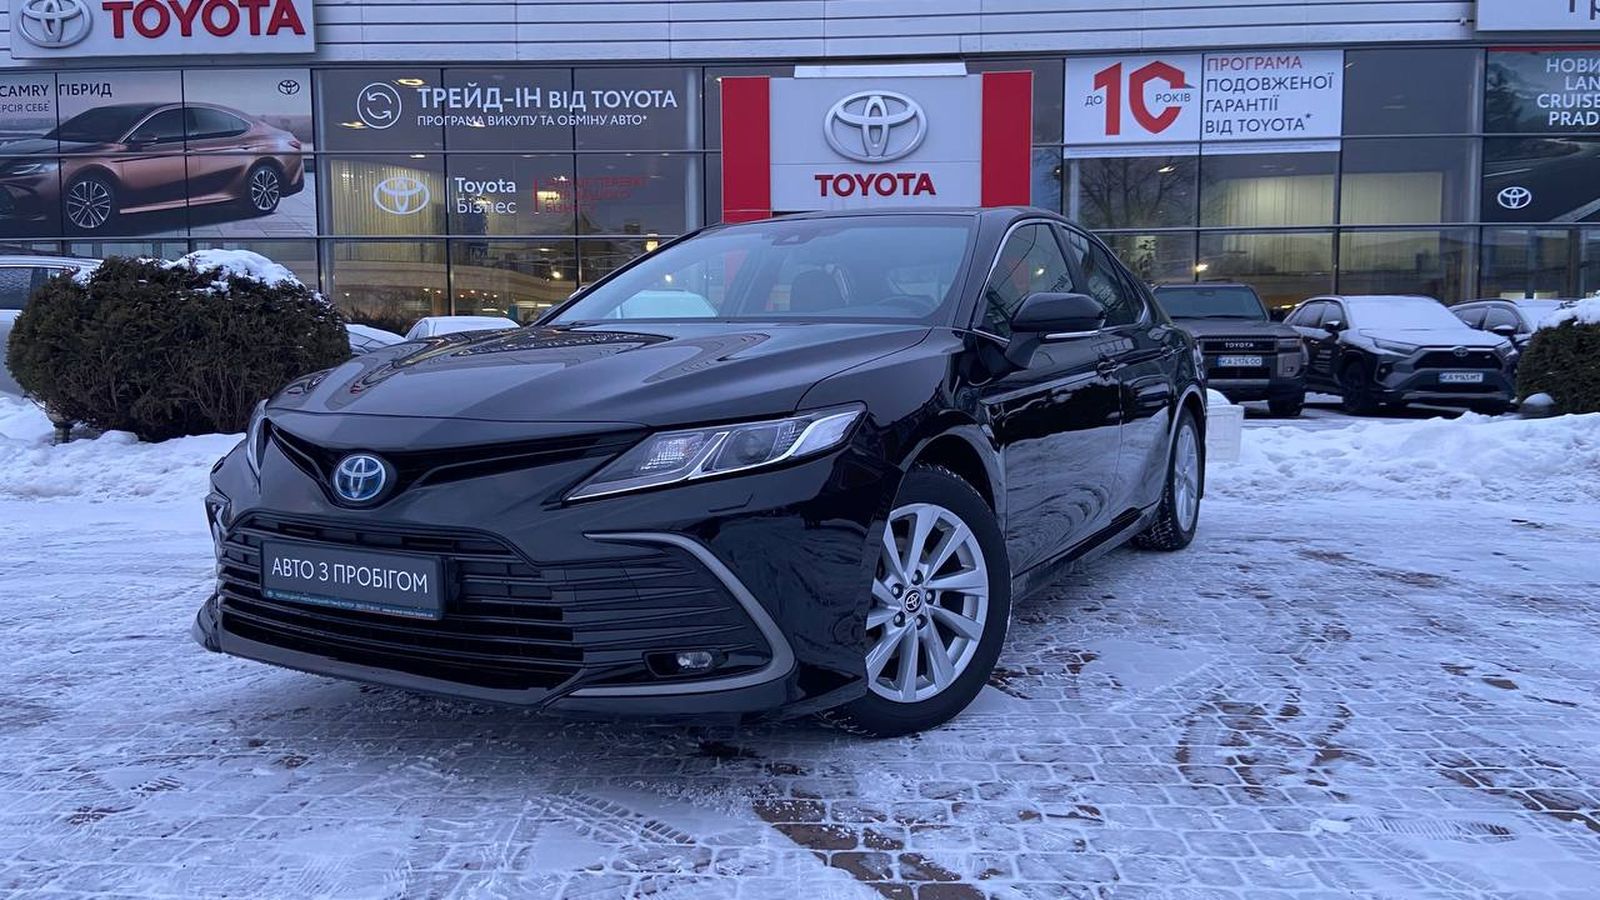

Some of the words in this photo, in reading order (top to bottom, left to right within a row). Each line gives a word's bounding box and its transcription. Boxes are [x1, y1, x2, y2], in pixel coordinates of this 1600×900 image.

[102, 0, 306, 38] TOYOTA
[1206, 56, 1303, 71] ПРОГРАМА
[0, 84, 49, 98] CAMRY
[59, 83, 112, 98] ГІБРИД
[1206, 72, 1335, 94] ПОДОВЖЕНОЇ
[417, 82, 542, 113] ТРЕЙД-ІН
[549, 91, 587, 112] ВІД
[591, 90, 678, 109] TOYOTA
[1085, 95, 1103, 107] ДО
[1155, 93, 1191, 103] РОКІВ
[1205, 94, 1280, 113] ГАРАНТІЇ
[417, 115, 485, 127] ПРОГРАМА
[488, 115, 538, 126] ВИКУПУ
[540, 115, 555, 126] ТА
[557, 115, 608, 126] ОБМІНУ
[1205, 119, 1233, 135] ВІД
[454, 177, 516, 196] Toyota
[814, 173, 937, 197] TOYOTA
[271, 557, 315, 580] АВТО
[319, 562, 329, 581] З
[333, 564, 428, 594] ПРОБІГОМ
